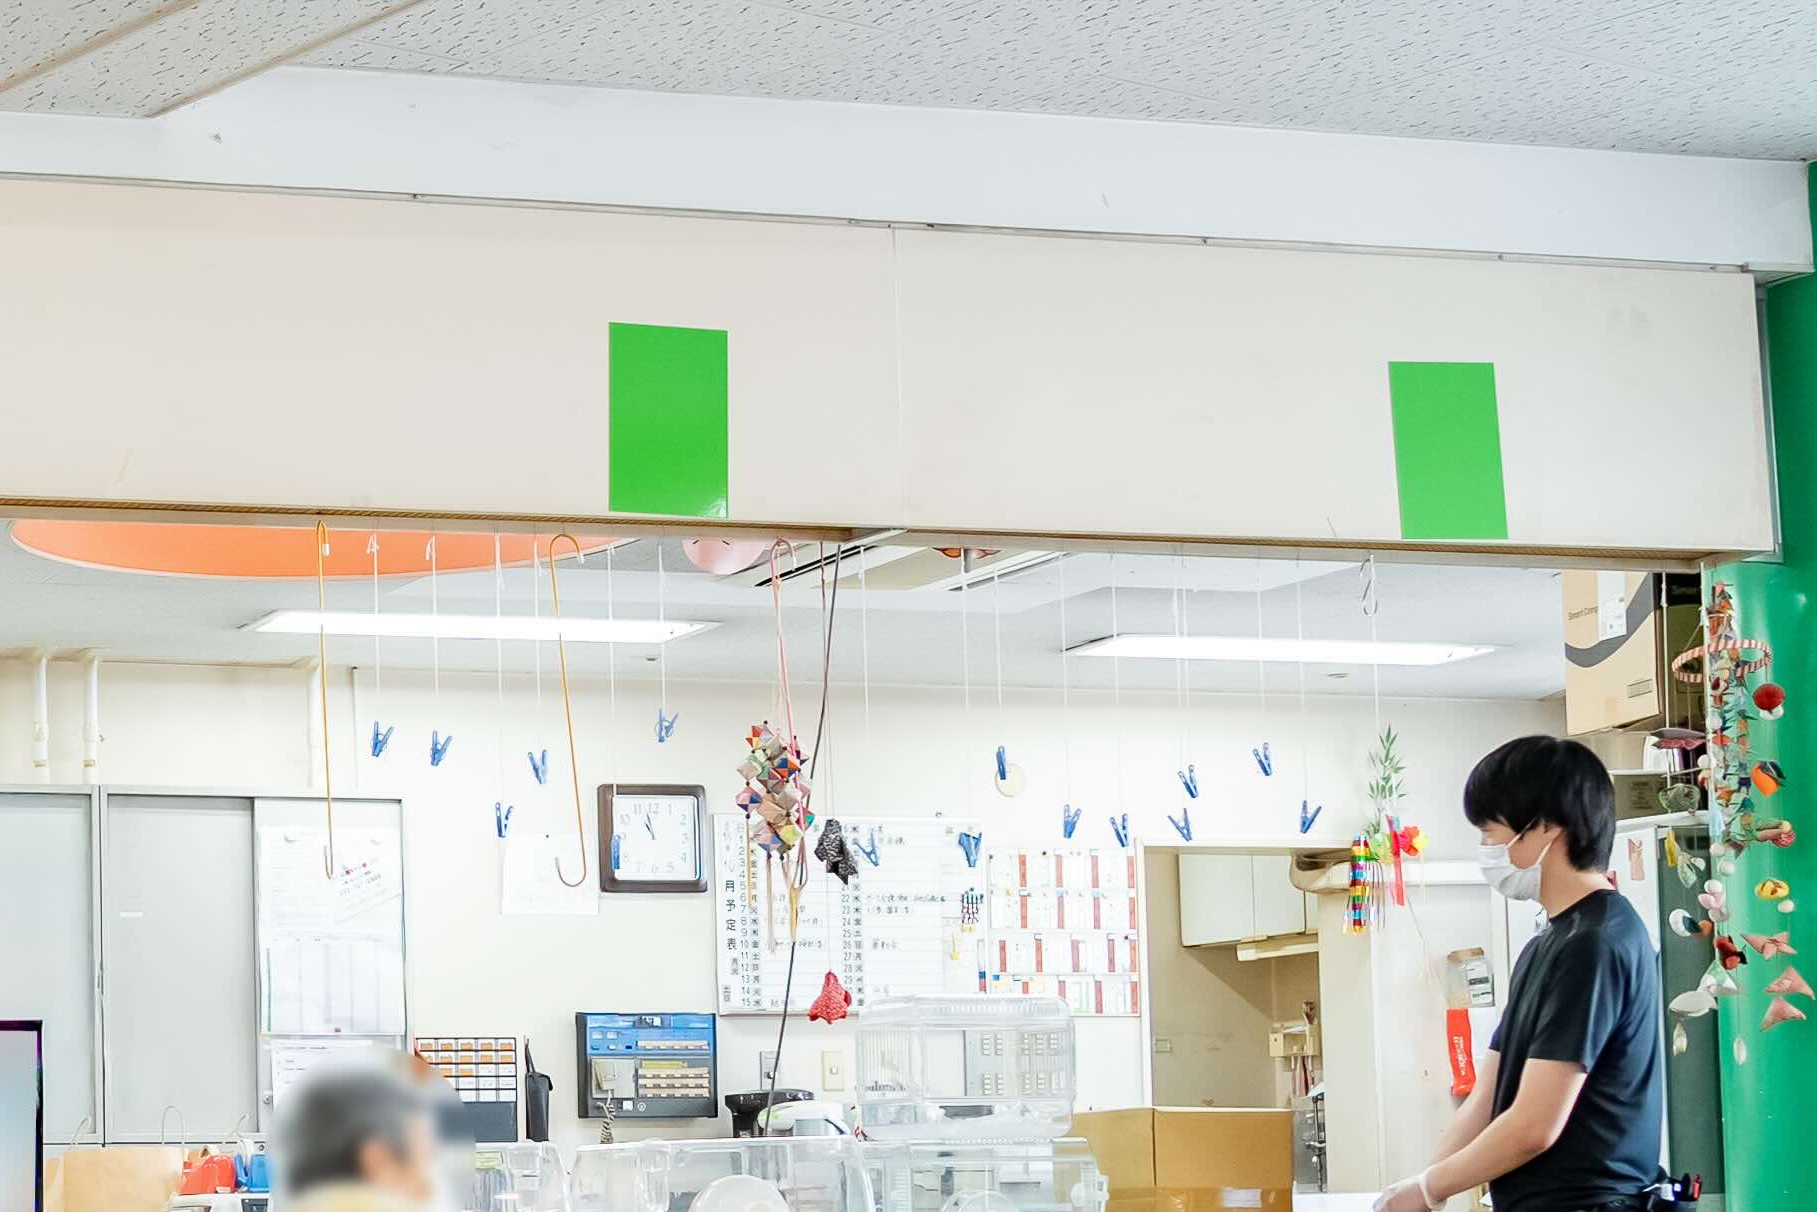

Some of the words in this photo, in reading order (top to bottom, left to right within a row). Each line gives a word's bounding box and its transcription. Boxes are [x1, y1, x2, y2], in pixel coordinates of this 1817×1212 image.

[648, 802, 660, 815] 12
[725, 879, 737, 951] 月予定表
